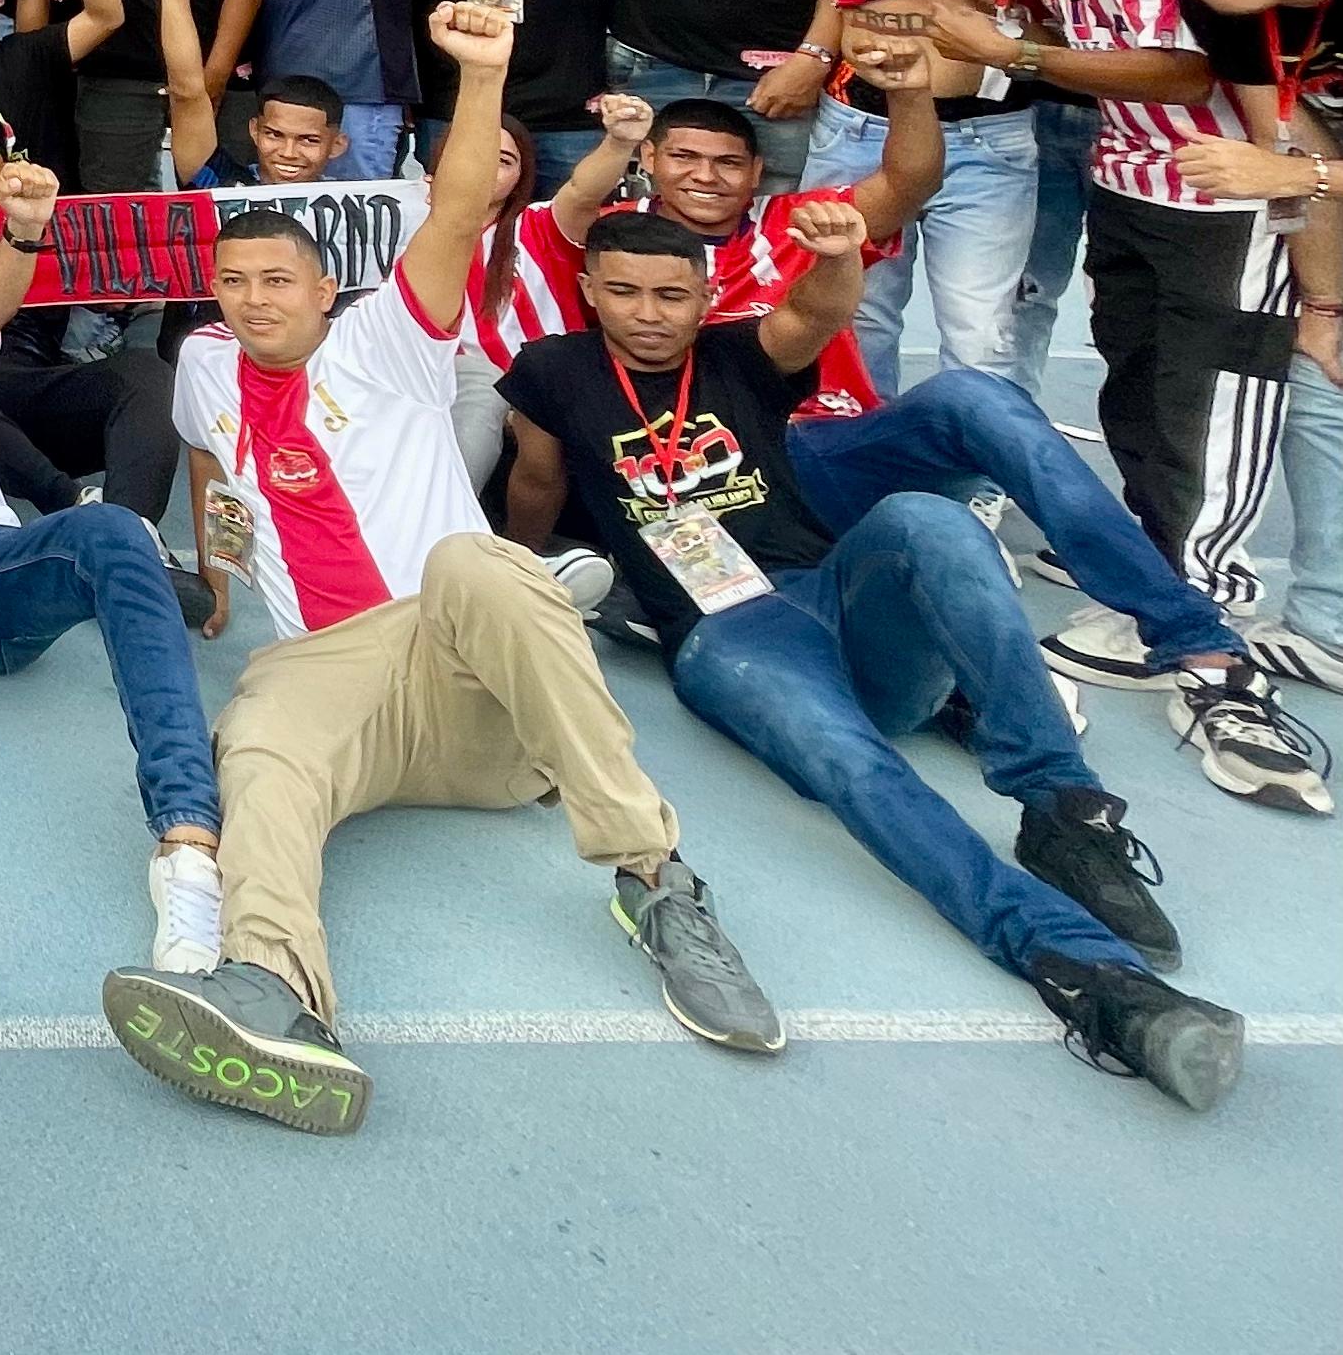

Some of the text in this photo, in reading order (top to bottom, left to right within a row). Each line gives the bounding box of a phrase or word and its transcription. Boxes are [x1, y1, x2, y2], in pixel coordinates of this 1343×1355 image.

[50, 199, 209, 296] VILLA
[613, 426, 744, 499] 100
[126, 1003, 353, 1121] LACOSTE
